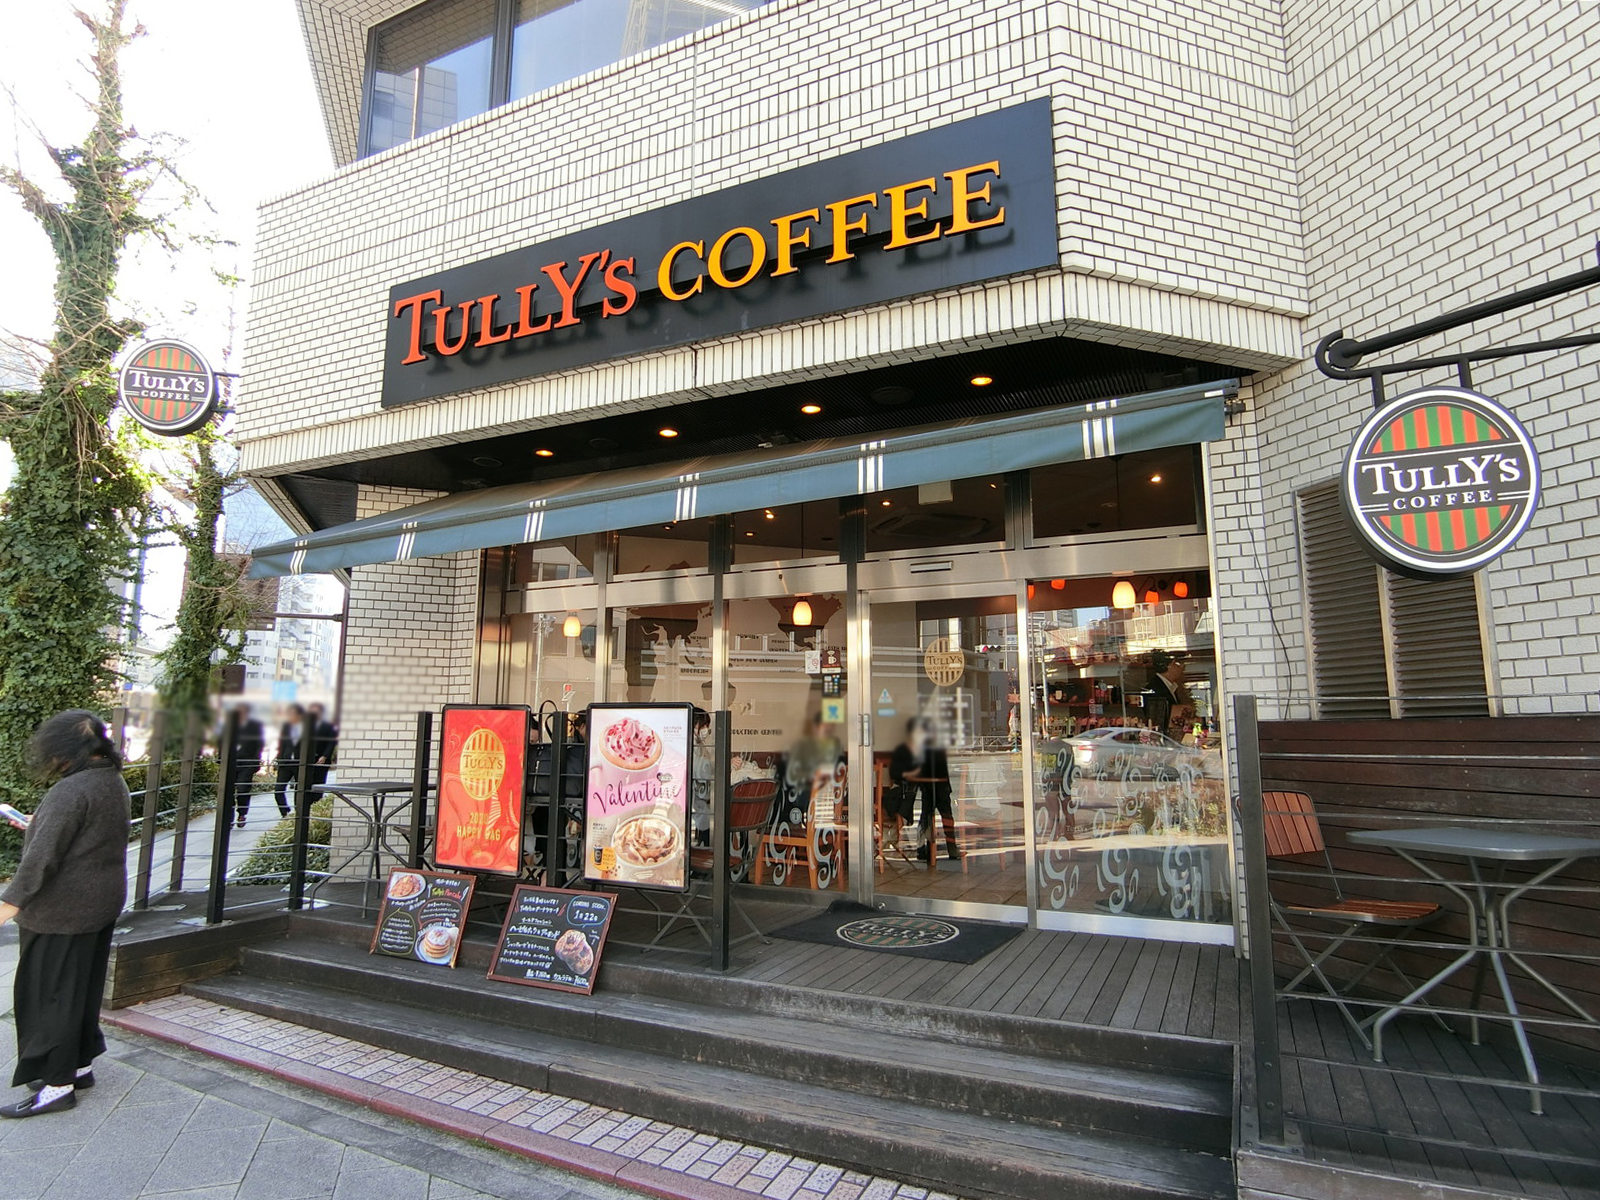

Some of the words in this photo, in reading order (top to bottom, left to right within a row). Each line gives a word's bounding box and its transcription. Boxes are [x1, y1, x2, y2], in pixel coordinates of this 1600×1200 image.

[393, 248, 638, 366] TULLY'S
[656, 160, 1007, 302] COFFEE
[128, 370, 206, 394] TULLY'S
[140, 389, 191, 401] COFFEE
[1361, 453, 1522, 495] TULLY'S
[1392, 489, 1493, 511] COFFEE
[926, 655, 963, 666] TULLY'S
[592, 779, 682, 815] Valentine
[456, 825, 482, 839] HAPPY
[484, 828, 501, 841] BAG
